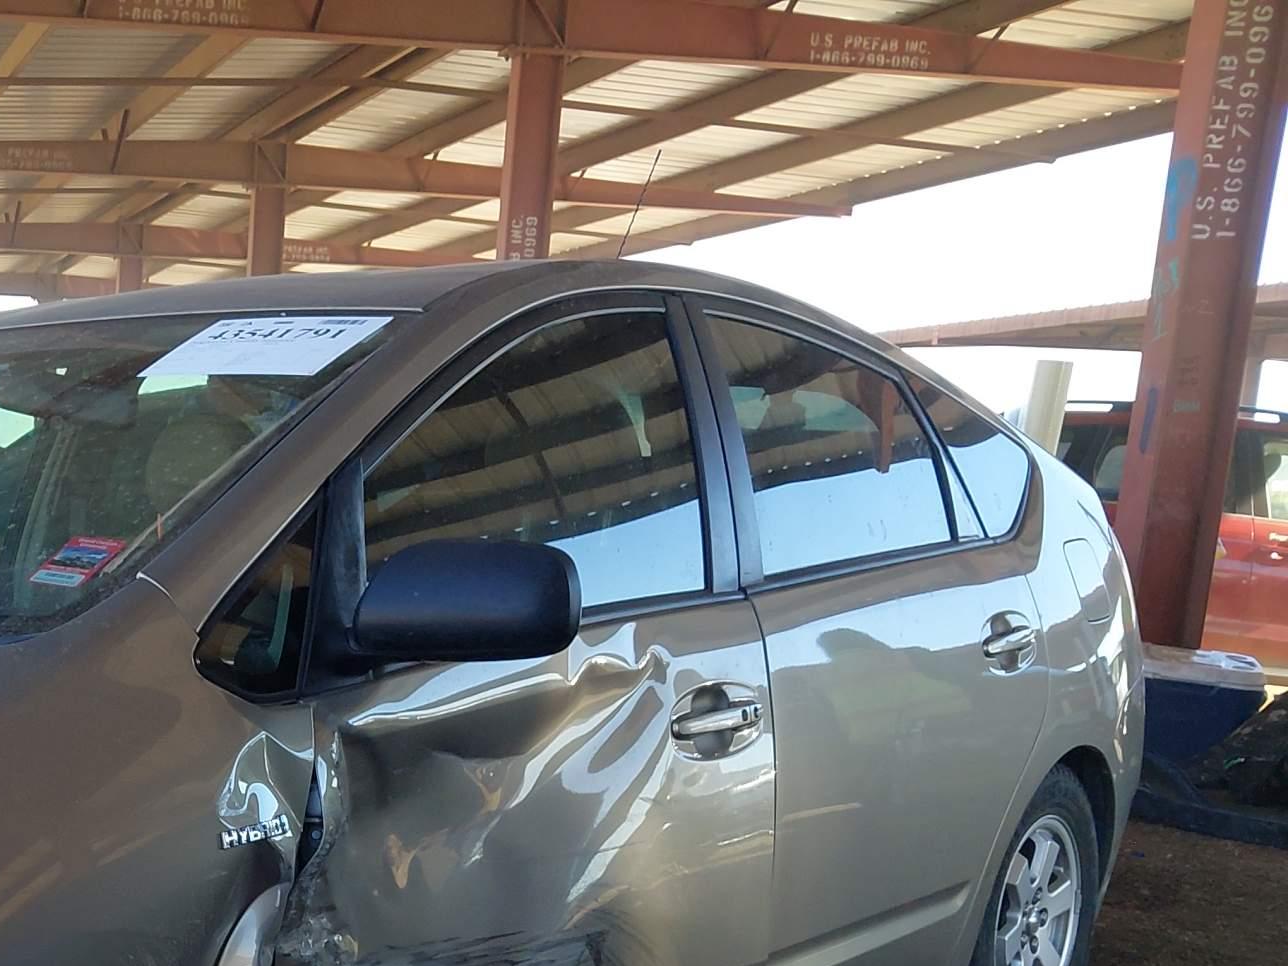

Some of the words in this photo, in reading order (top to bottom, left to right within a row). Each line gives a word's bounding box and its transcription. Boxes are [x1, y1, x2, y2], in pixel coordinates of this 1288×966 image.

[843, 34, 899, 53] PREFAB
[904, 39, 932, 56] INC.
[1202, 55, 1239, 169] PREFAB
[1192, 187, 1218, 240] U.S.
[208, 327, 347, 340] 43541791
